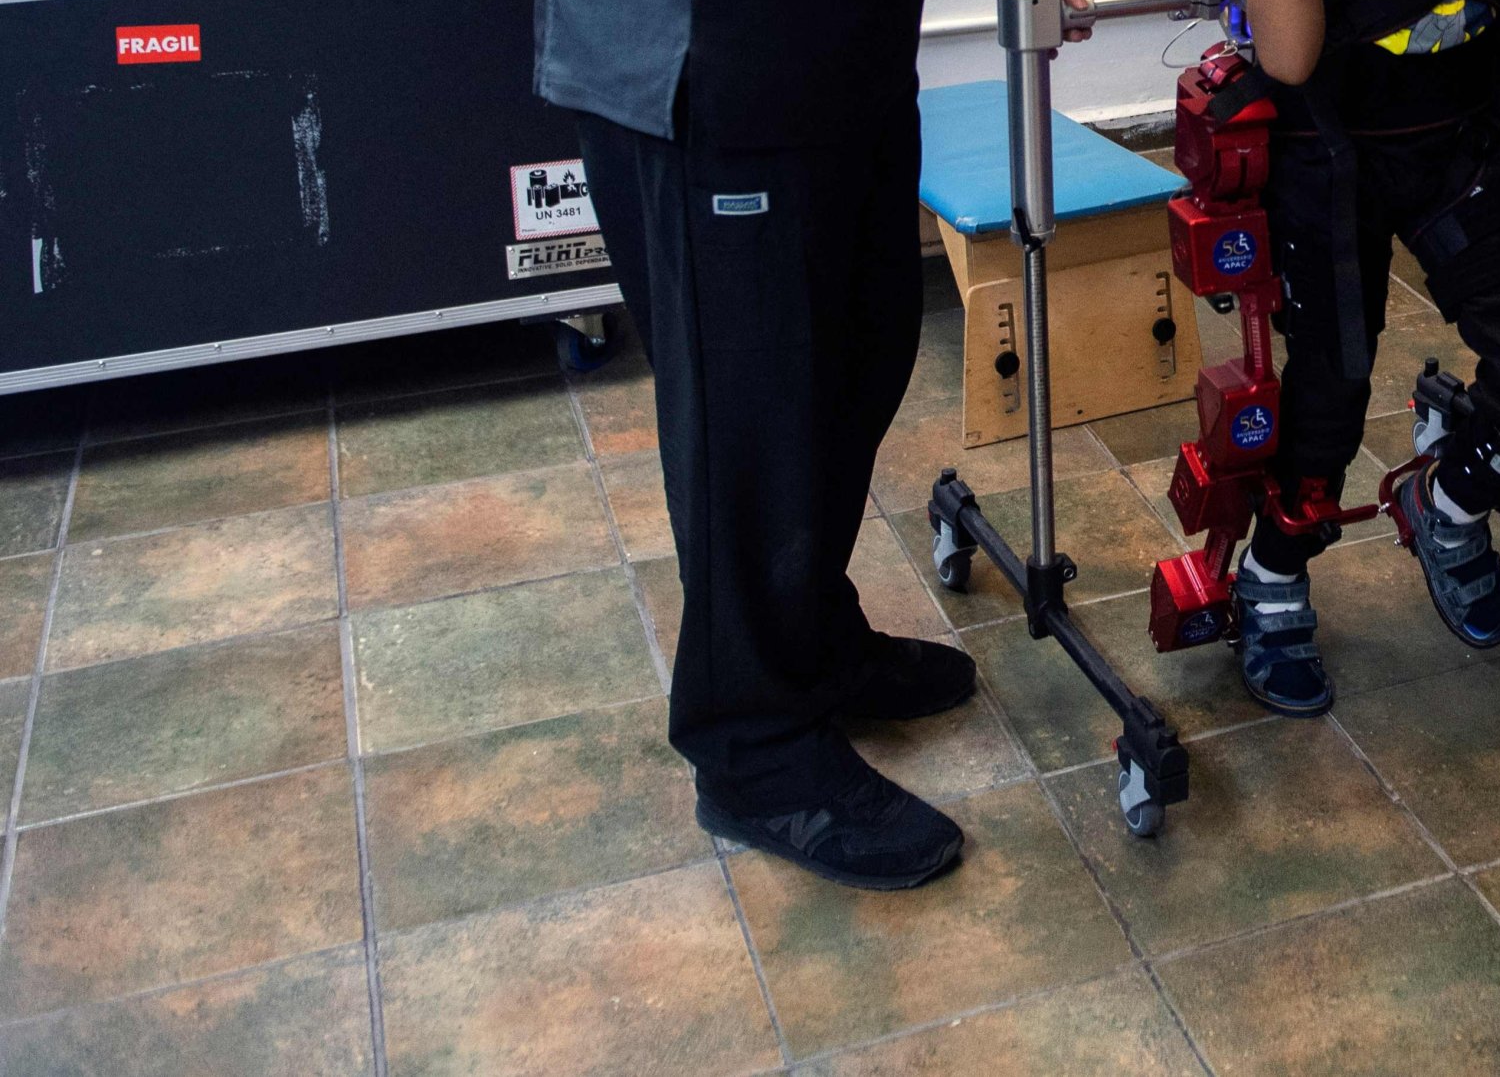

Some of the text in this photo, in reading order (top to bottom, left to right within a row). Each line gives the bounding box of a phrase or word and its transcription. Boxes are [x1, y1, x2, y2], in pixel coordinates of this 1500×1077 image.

[118, 35, 200, 55] FRAGIL
[535, 207, 581, 220] UN 3481
[1224, 261, 1246, 270] APAC
[1242, 434, 1264, 444] APAC
